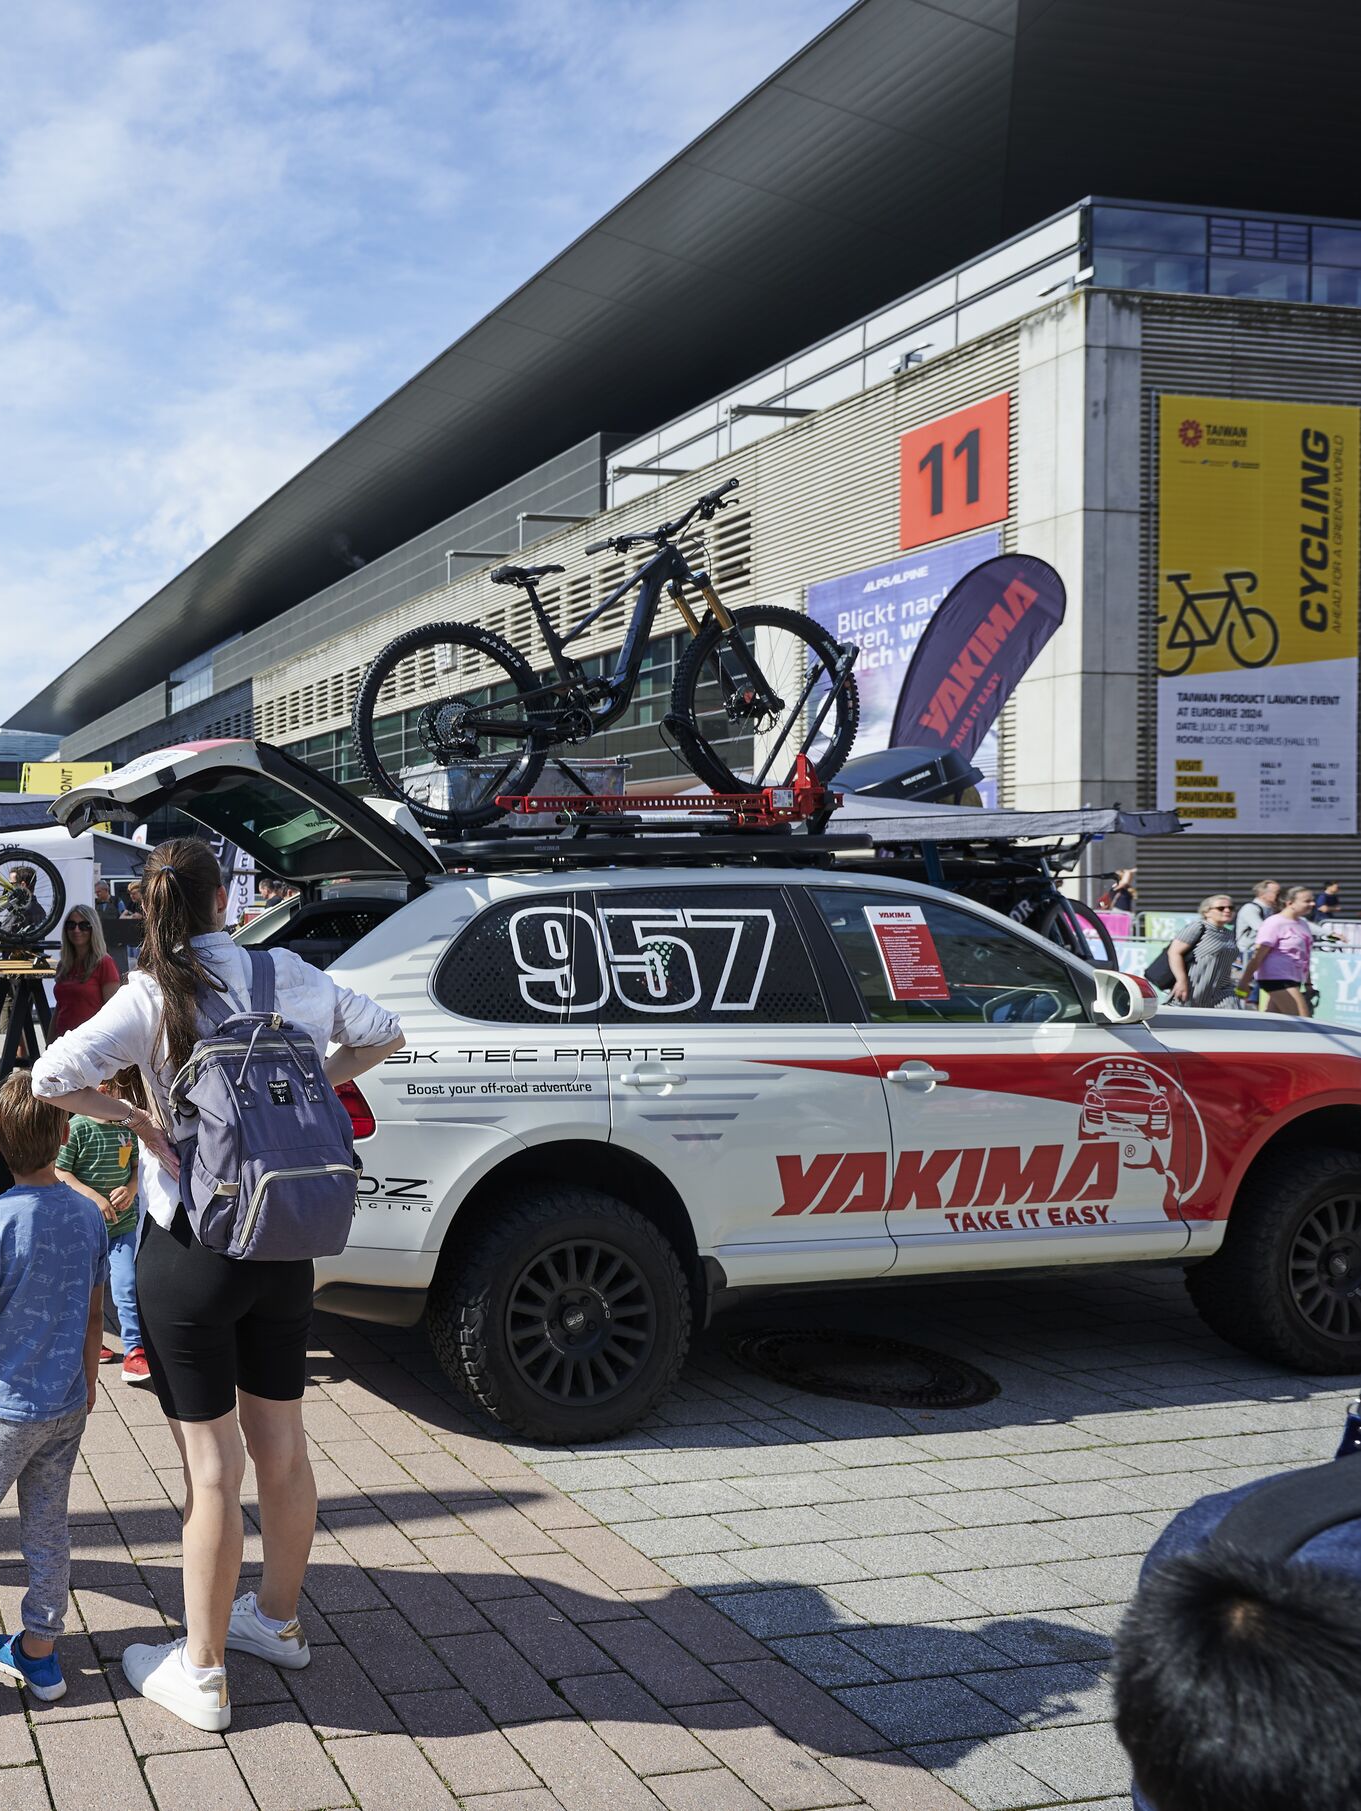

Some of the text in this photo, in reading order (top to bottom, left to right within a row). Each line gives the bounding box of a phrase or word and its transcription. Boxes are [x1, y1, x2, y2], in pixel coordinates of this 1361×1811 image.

[1206, 424, 1247, 437] TAIWAN
[918, 429, 980, 516] 11
[1333, 434, 1344, 484] WORLD
[1300, 428, 1331, 632] CYCLING
[1333, 549, 1342, 559] A
[1333, 562, 1343, 587] FOR
[837, 601, 896, 634] Blickt
[1332, 590, 1343, 634] AHEAD
[479, 636, 522, 668] MAXXIS
[919, 578, 1038, 738] YAKIMA
[950, 672, 1002, 748] TAKE IT EASY
[1177, 693, 1340, 705] TAIWAN PRODUCT LAUNCH EVENT
[1177, 707, 1263, 718] AT EUROBIKE 2024
[1235, 737, 1252, 745] AND
[60, 768, 73, 796] ONIT
[901, 770, 931, 786] YAKIMA
[508, 906, 777, 1013] 957
[457, 1049, 538, 1062] TEC
[553, 1047, 685, 1062] PARTS
[407, 1081, 593, 1097] Boost your off-road adventure
[771, 1141, 1120, 1217] YAKIMA
[352, 1202, 432, 1213] CING
[944, 1205, 1112, 1233] TAKE IT EASY
